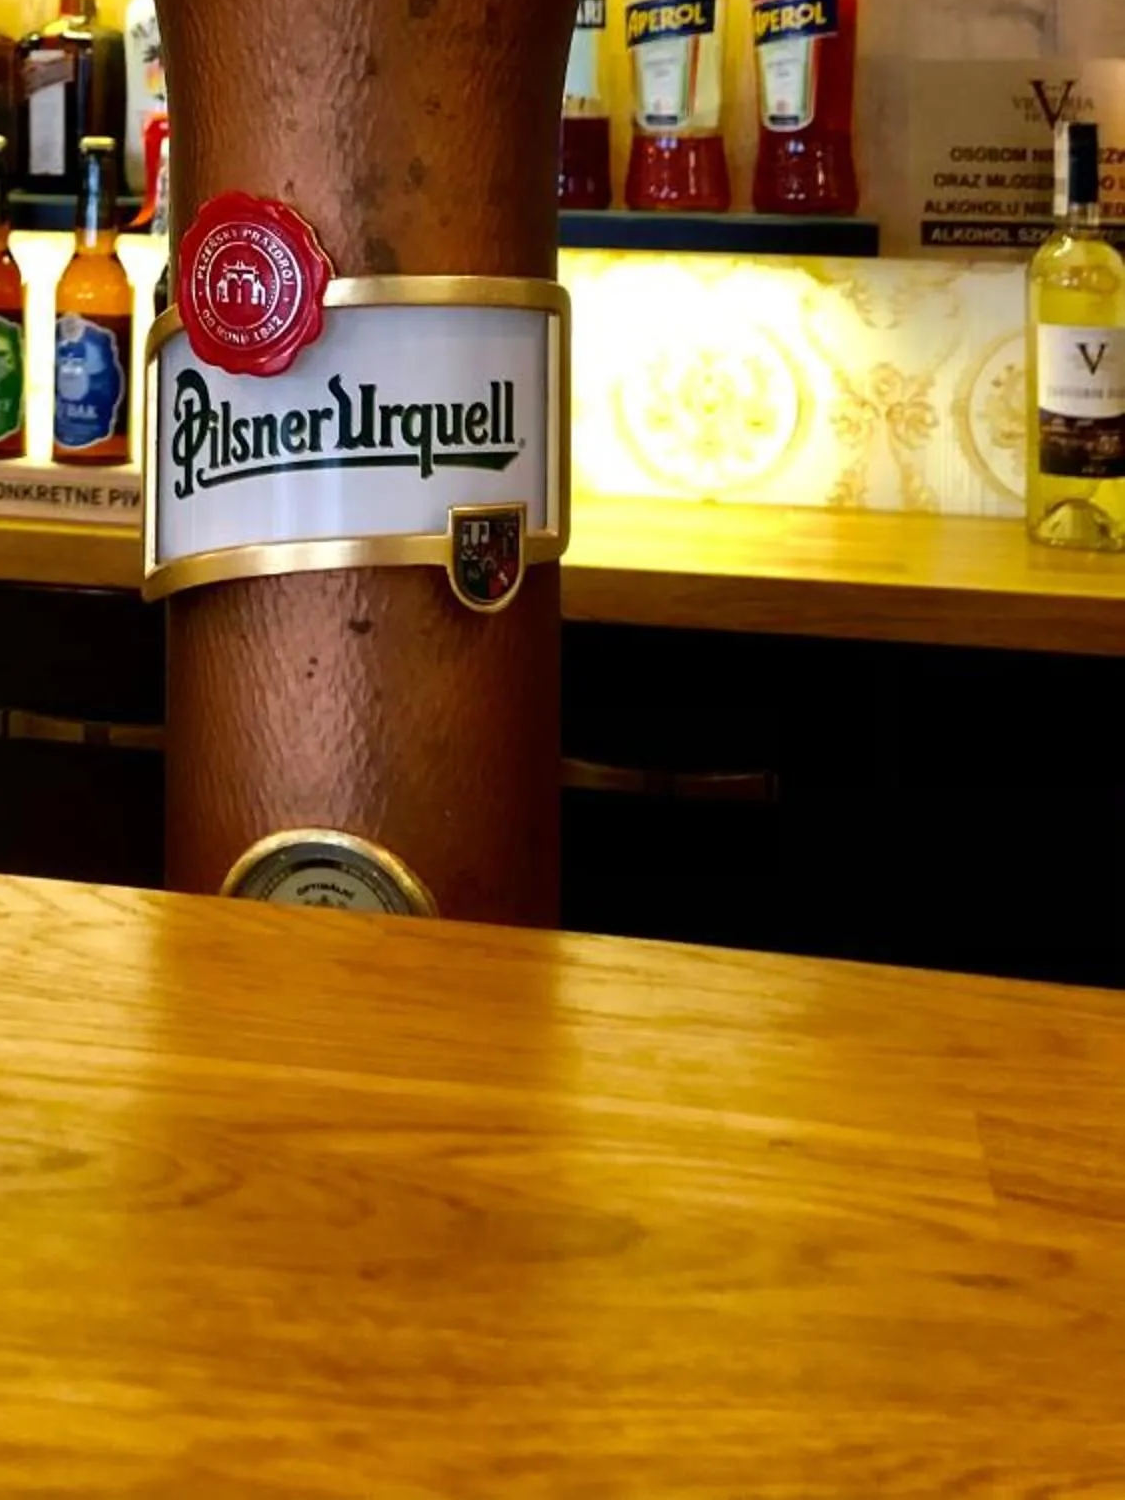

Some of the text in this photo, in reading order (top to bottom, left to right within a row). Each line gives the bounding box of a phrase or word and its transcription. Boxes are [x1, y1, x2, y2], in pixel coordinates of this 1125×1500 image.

[629, 2, 706, 35] APEROL
[172, 368, 515, 500] Pilsner Urquell
